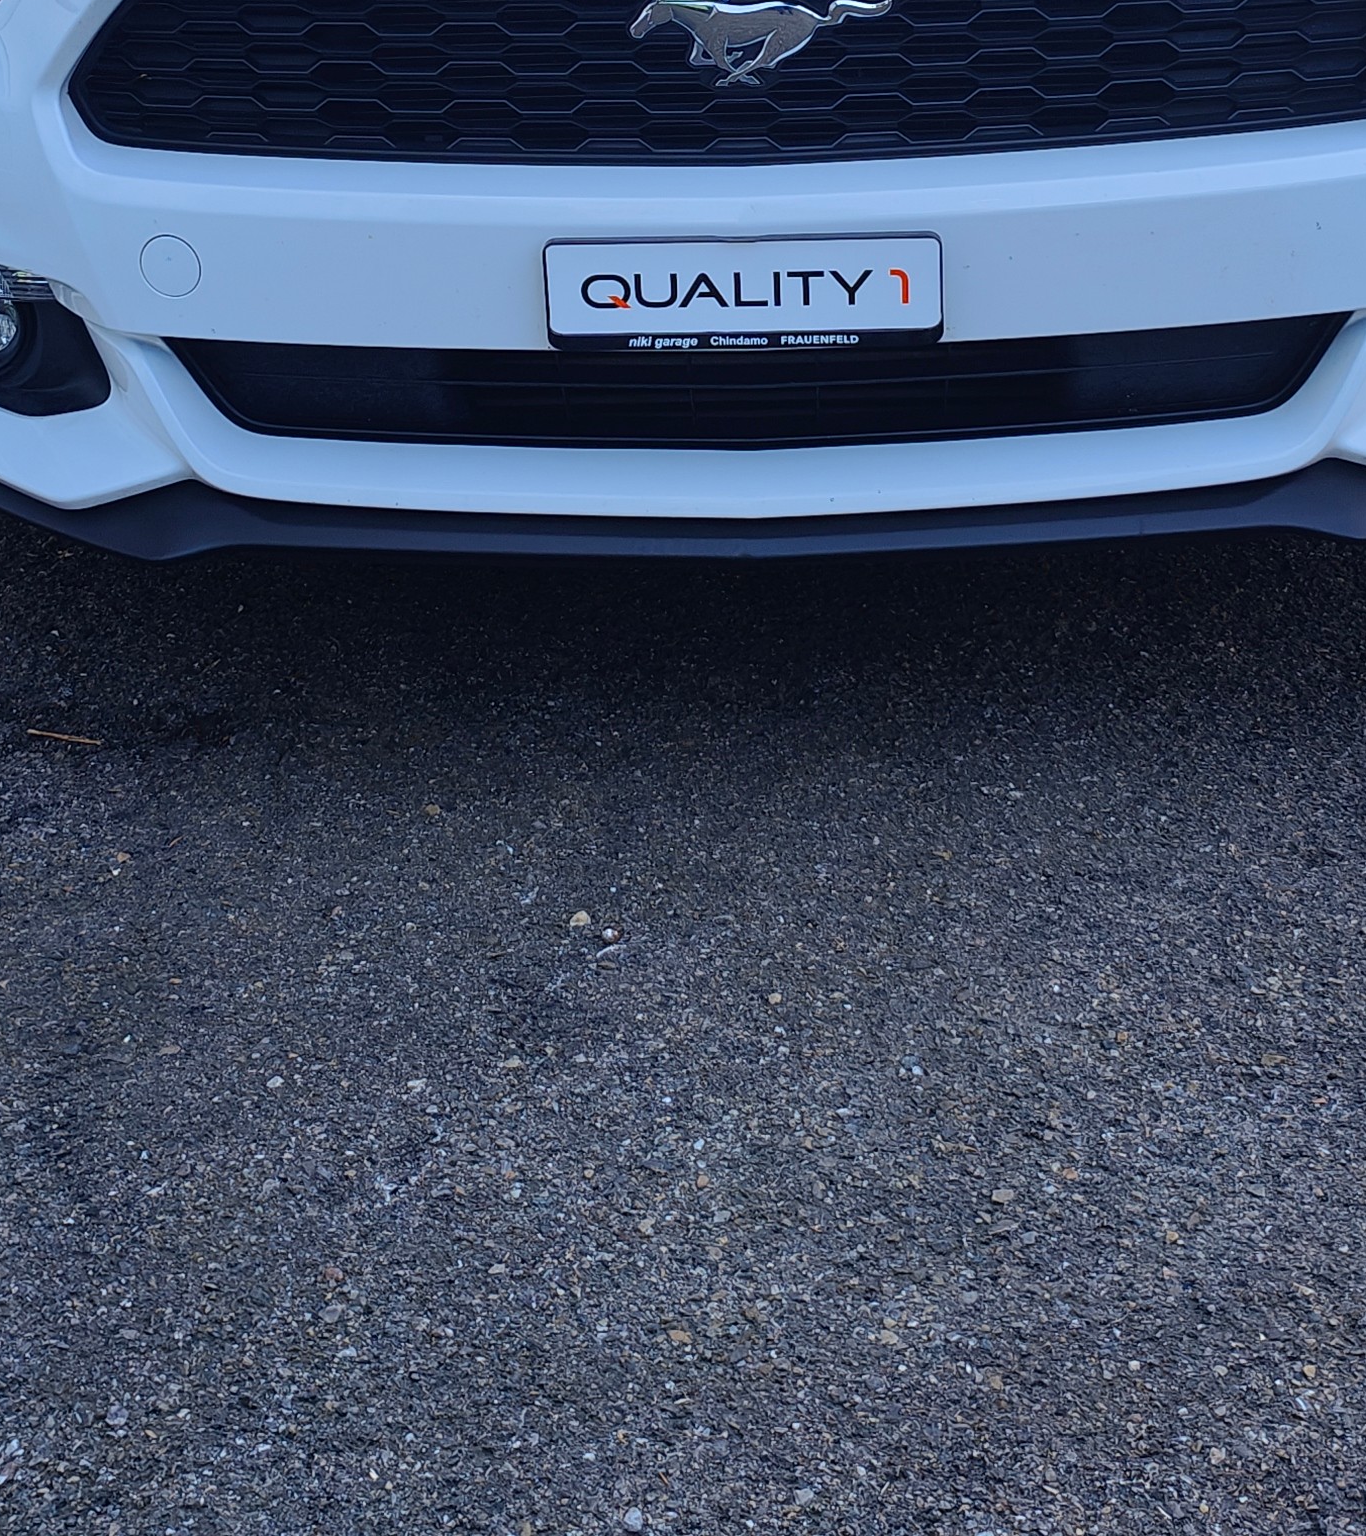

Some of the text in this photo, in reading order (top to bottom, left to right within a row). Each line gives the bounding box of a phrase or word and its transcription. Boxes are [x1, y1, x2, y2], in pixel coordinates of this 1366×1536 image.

[580, 268, 910, 309] QUALITY 1
[628, 334, 860, 349] niki garage Chindamo FRAUENFELD
